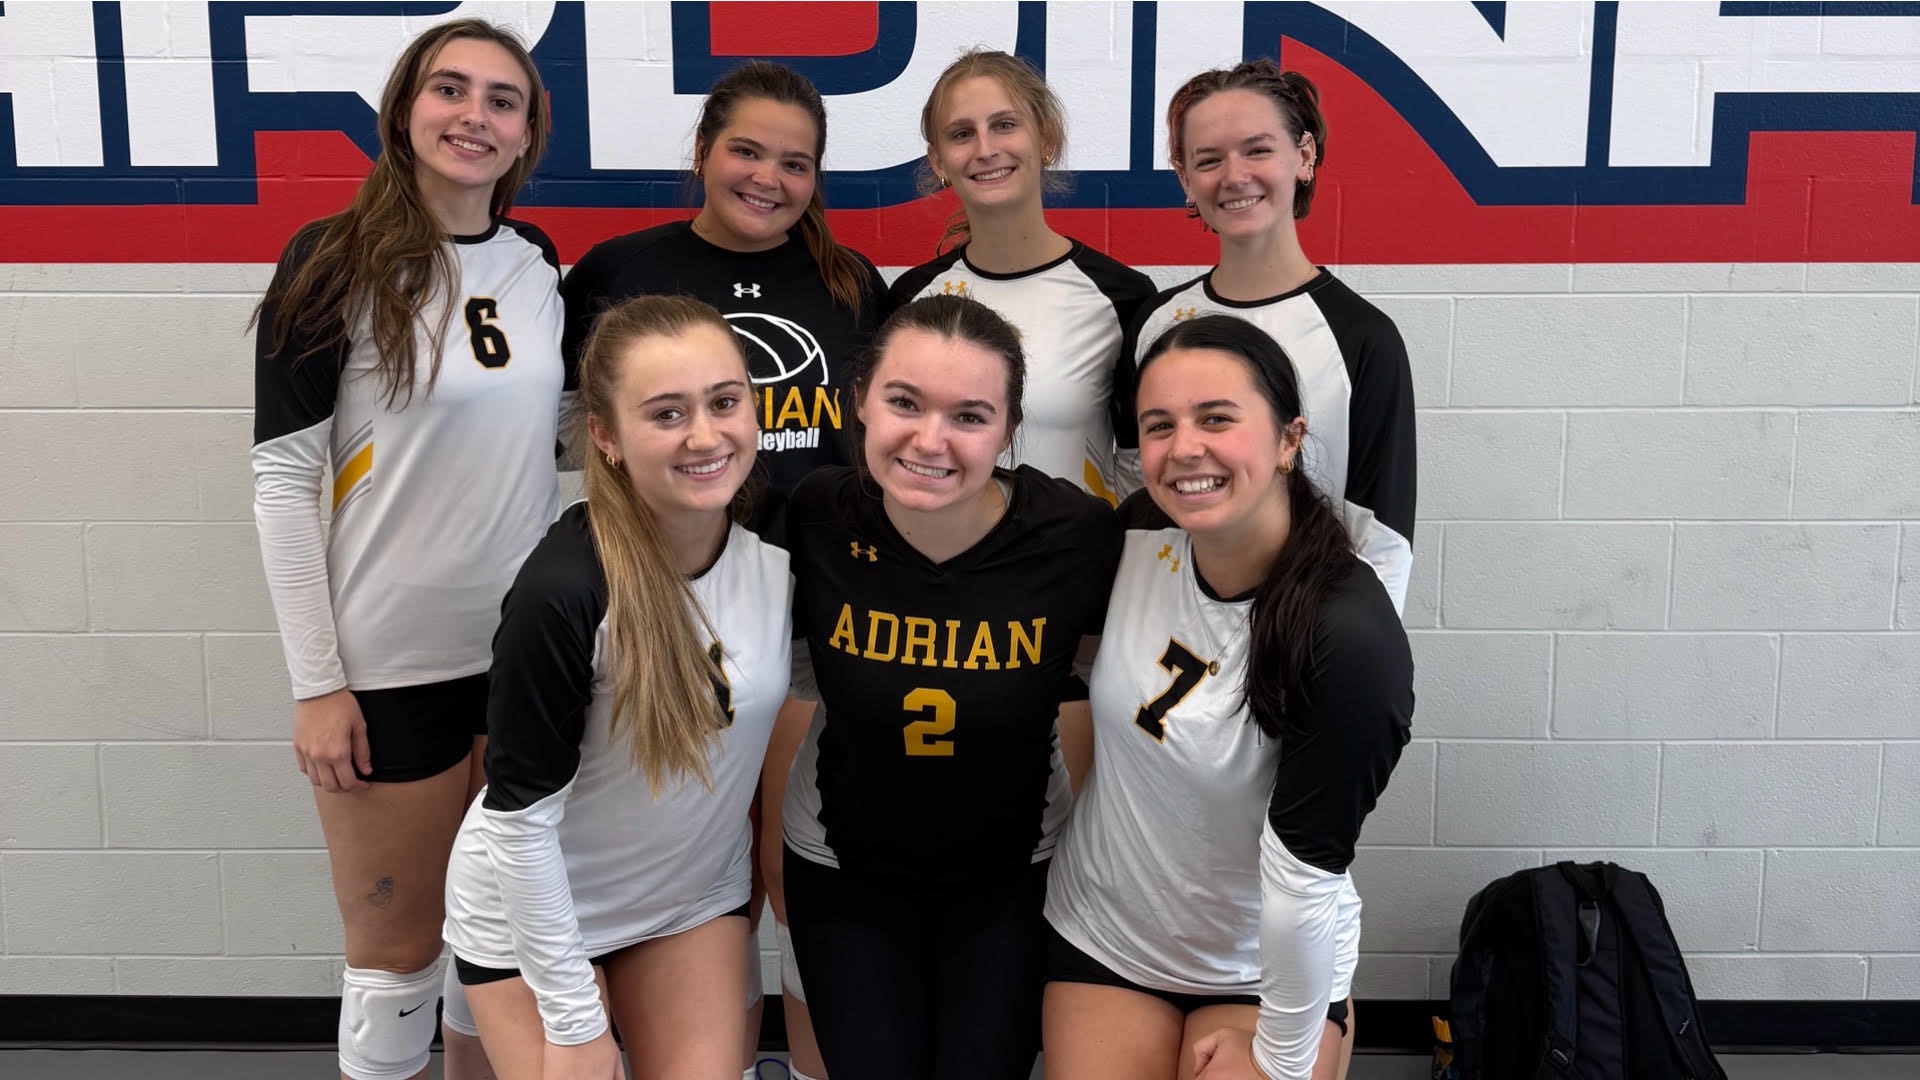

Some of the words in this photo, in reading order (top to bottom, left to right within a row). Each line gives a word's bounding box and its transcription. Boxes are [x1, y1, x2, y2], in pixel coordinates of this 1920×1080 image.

[463, 296, 511, 369] 6
[756, 386, 842, 430] IAN
[829, 603, 1047, 670] ADRIAN
[903, 687, 957, 757] 2
[1133, 636, 1209, 744] 7
